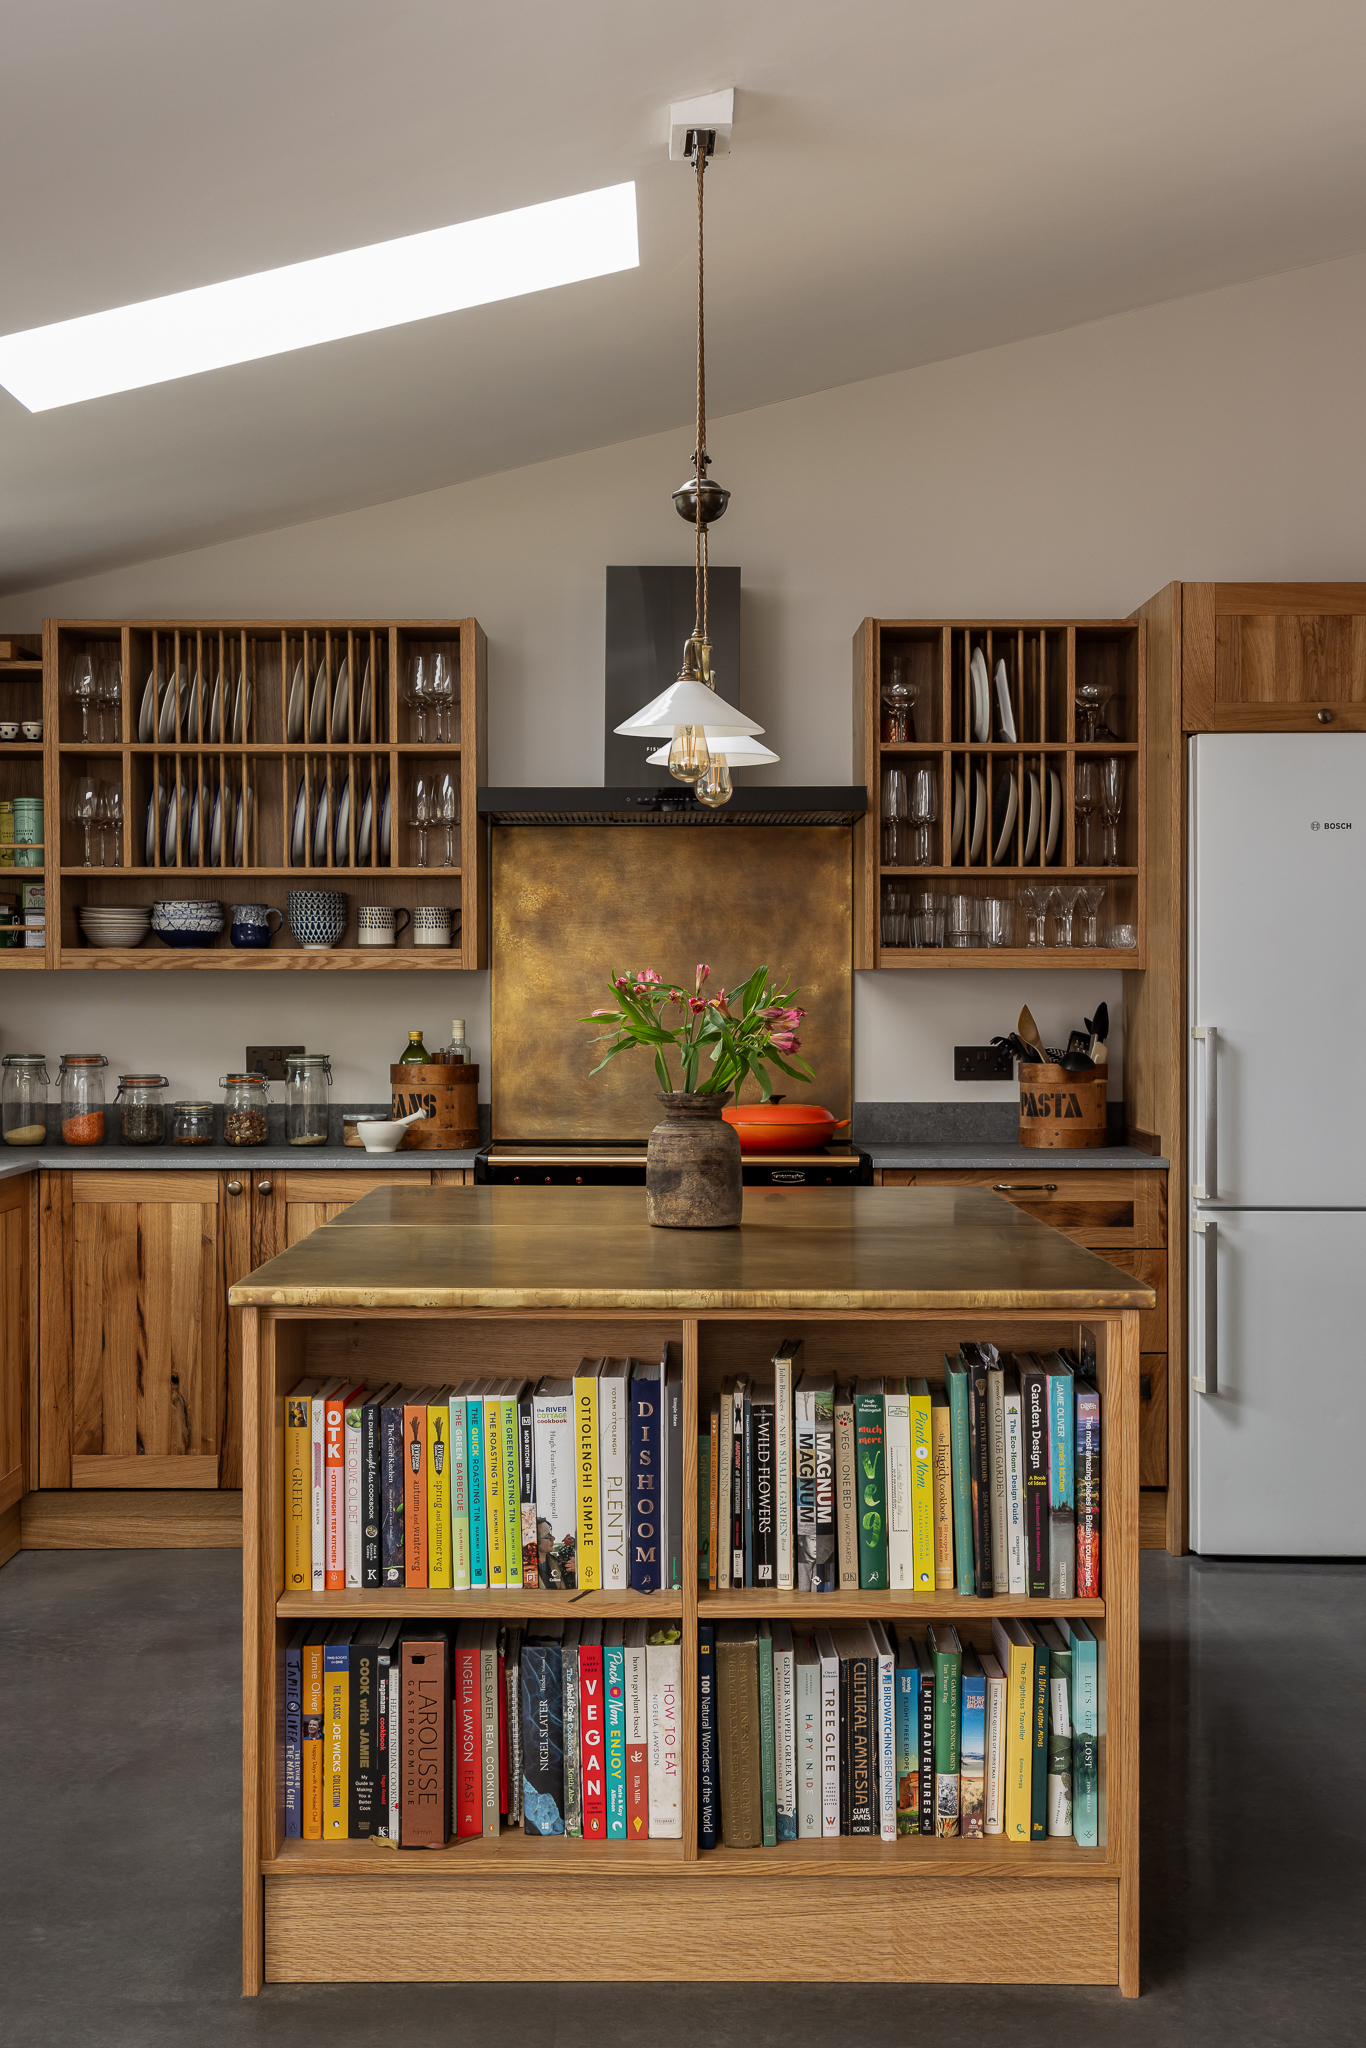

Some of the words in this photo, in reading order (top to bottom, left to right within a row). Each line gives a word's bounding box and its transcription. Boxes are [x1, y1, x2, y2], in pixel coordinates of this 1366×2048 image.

[392, 1094, 437, 1118] EANS
[1021, 1092, 1083, 1118] PASTA
[1031, 1384, 1041, 1428] Garden
[327, 1410, 341, 1459] OTK
[581, 1396, 591, 1488] OTTOLENGHI
[758, 1422, 770, 1462] WILD
[842, 1430, 850, 1450] VEG
[859, 1424, 882, 1434] much
[859, 1436, 882, 1444] more
[916, 1410, 929, 1445] Pinch
[994, 1408, 1003, 1454] COTTAGE
[349, 1438, 357, 1455] THE
[842, 1452, 850, 1462] IN
[934, 1444, 950, 1481] higgidy
[1030, 1430, 1041, 1469] Design
[349, 1457, 357, 1484] OLIVE
[365, 1450, 376, 1483] weight-loss
[635, 1402, 656, 1562] DISHOOM
[800, 1434, 814, 1522] MAGNUM
[816, 1434, 832, 1522] MAGNUM
[842, 1466, 850, 1485] ONE
[917, 1460, 930, 1489] Nom
[996, 1456, 1004, 1498] GARDEN
[292, 1468, 303, 1521] GREECE
[349, 1487, 357, 1501] OIL
[434, 1480, 442, 1508] spring
[758, 1469, 771, 1533] FLOWERS
[844, 1490, 852, 1509] BED
[939, 1482, 948, 1522] cookbook
[349, 1505, 358, 1524] DIET
[583, 1497, 593, 1546] SIMPLE
[607, 1477, 623, 1556] PLENTY
[412, 1558, 420, 1572] veg
[434, 1558, 442, 1572] veg
[312, 1652, 320, 1680] Jamie
[360, 1658, 369, 1695] COOK
[462, 1656, 472, 1704] NIGELLA
[608, 1652, 622, 1684] Pinch
[632, 1674, 639, 1682] to
[312, 1682, 321, 1712] Oliver
[333, 1685, 341, 1696] THE
[630, 1684, 638, 1693] go
[702, 1674, 710, 1694] 100
[853, 1662, 866, 1732] CULTURAL
[333, 1697, 341, 1720] CLASSIC
[360, 1698, 369, 1725] with
[610, 1699, 623, 1725] Nom
[631, 1694, 641, 1738] plant-based
[664, 1684, 675, 1720] HOW
[702, 1697, 711, 1729] Natural
[826, 1689, 835, 1728] TREE
[333, 1722, 341, 1740] JOE
[540, 1700, 548, 1738] SLATER
[665, 1726, 675, 1745] TO
[884, 1687, 892, 1755] BIRDWATCHING
[360, 1730, 369, 1768] JAMIE
[418, 1680, 438, 1804] LAROUSSE
[464, 1710, 473, 1762] LAWSON
[586, 1680, 600, 1795] VEGAN
[702, 1730, 712, 1772] Wonders
[826, 1732, 835, 1772] GLEE
[540, 1741, 549, 1771] NIGEL
[610, 1730, 621, 1779] ENJOY
[666, 1753, 676, 1776] EAT
[855, 1736, 868, 1805] AMNESIA
[465, 1771, 474, 1804] FEAST
[486, 1757, 494, 1807] COOKING
[703, 1774, 712, 1786] of
[703, 1787, 712, 1803] the
[884, 1760, 893, 1811] BEGINNERS
[704, 1806, 712, 1833] World
